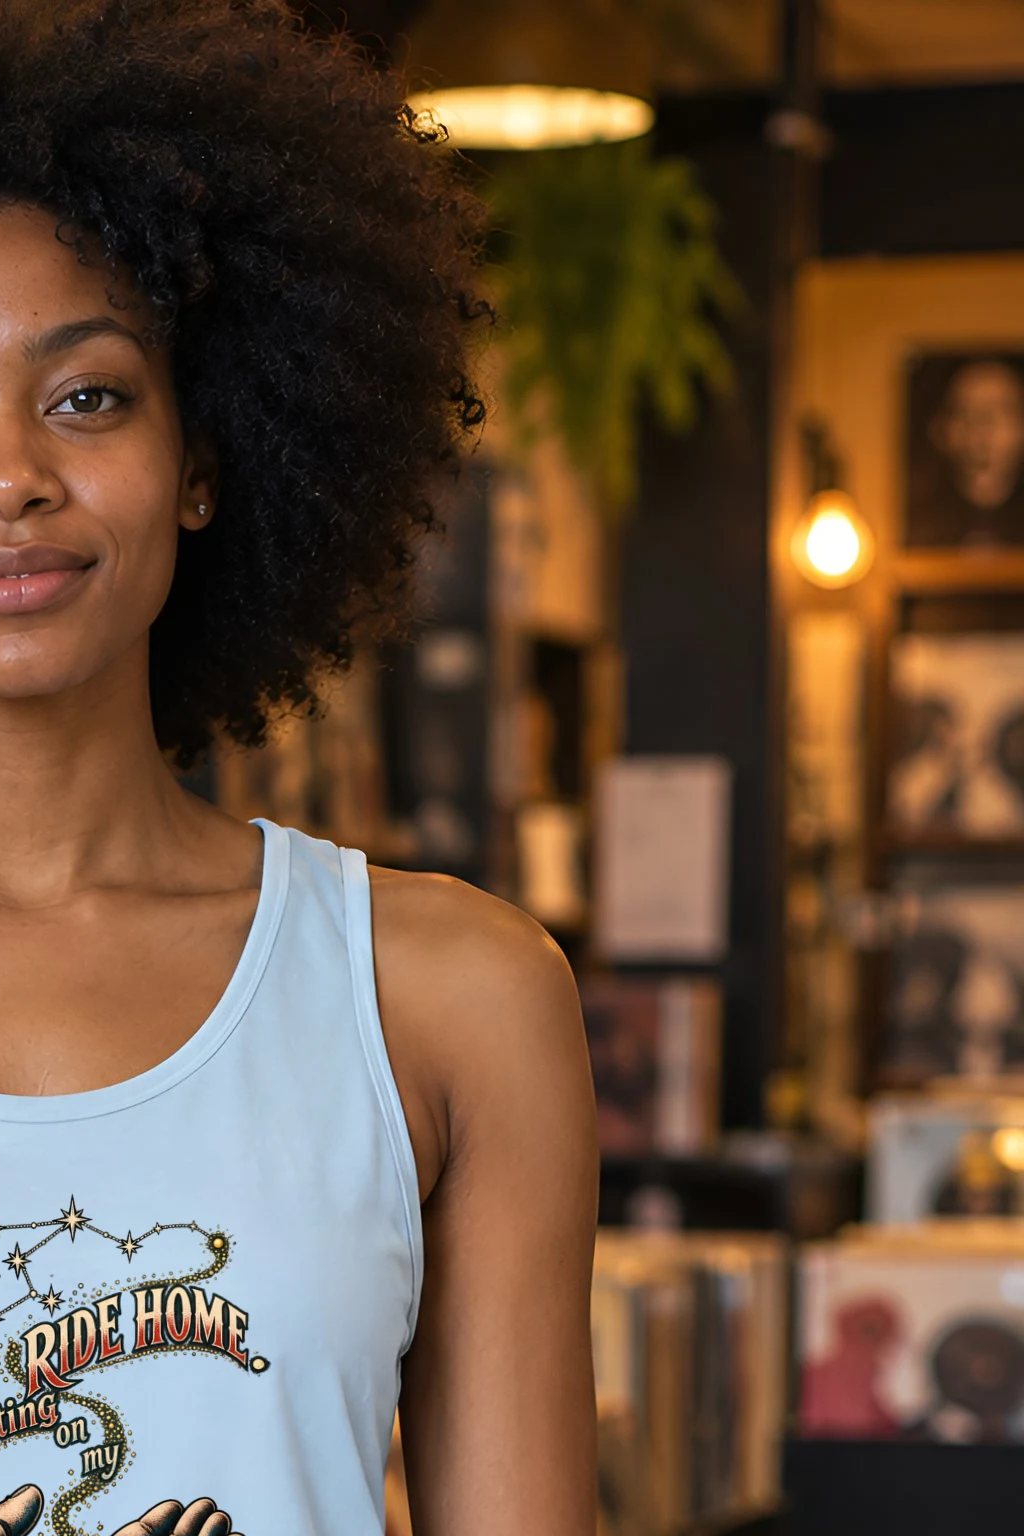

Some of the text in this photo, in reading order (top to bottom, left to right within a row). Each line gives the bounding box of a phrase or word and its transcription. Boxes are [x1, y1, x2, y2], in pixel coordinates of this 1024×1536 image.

[20, 1292, 125, 1399] RIDE
[54, 1416, 91, 1449] on
[79, 1443, 122, 1481] my
